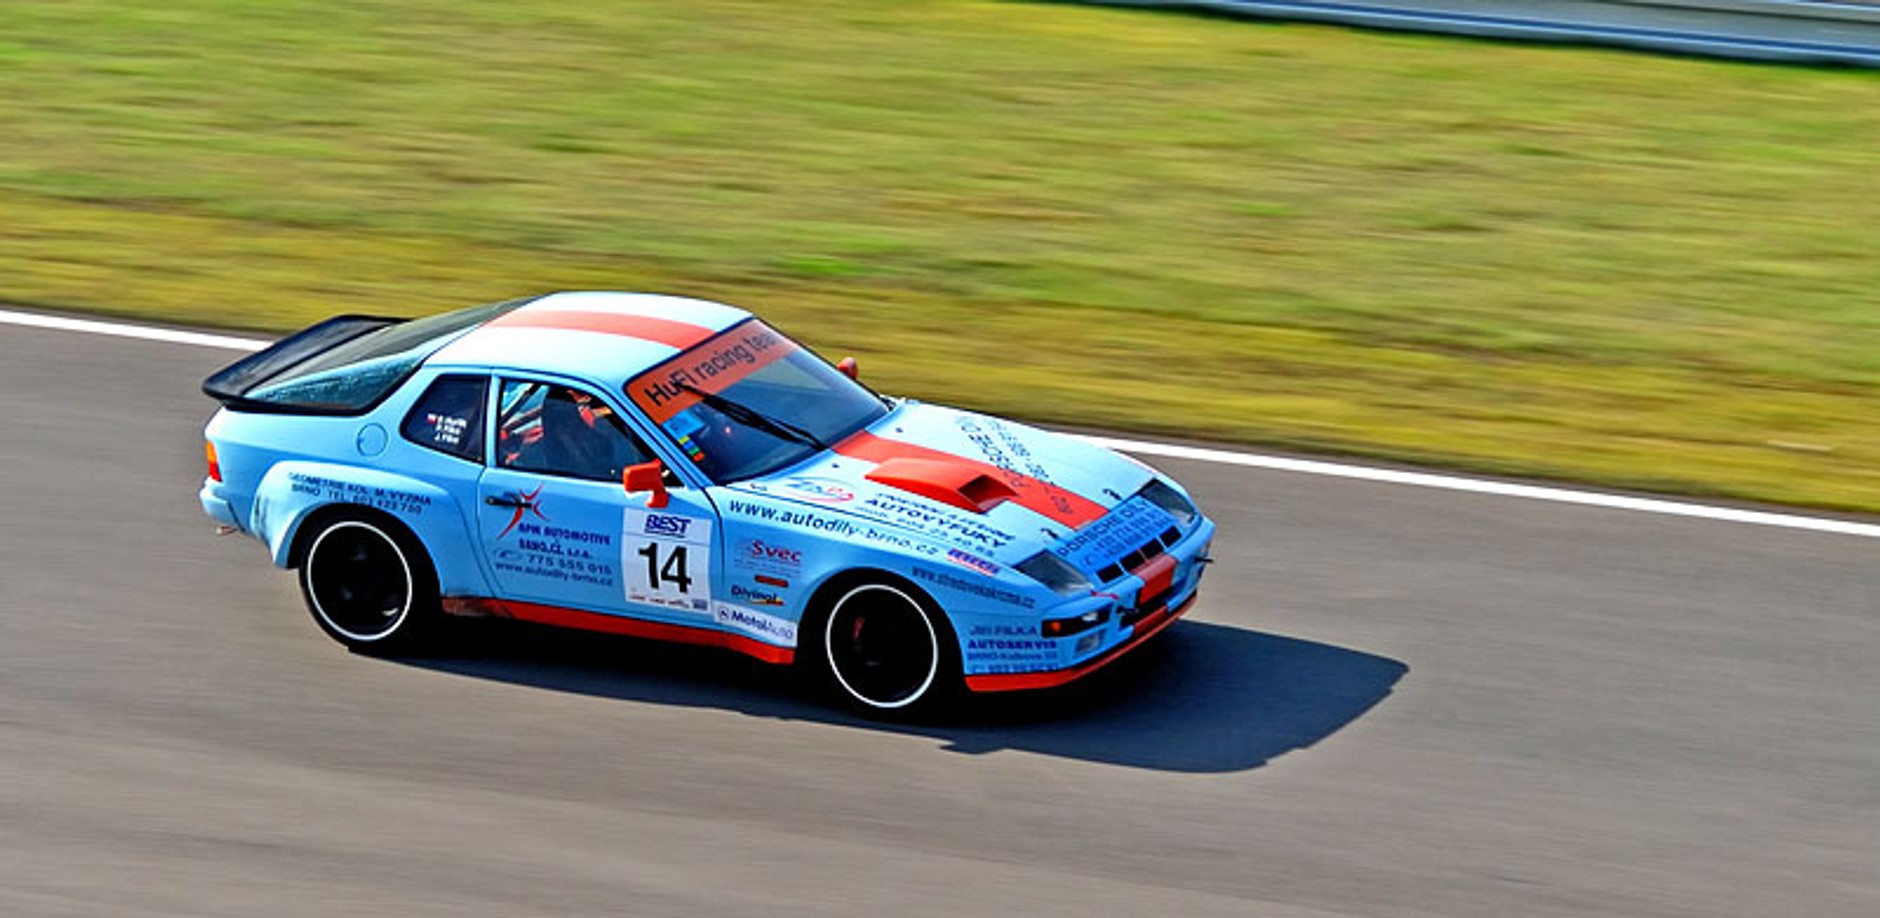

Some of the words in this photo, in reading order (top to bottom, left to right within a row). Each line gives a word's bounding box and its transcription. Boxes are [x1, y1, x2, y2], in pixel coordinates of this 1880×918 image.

[644, 368, 698, 407] HuFi
[695, 344, 755, 380] racing
[743, 331, 782, 352] tea
[645, 513, 693, 535] BEST
[637, 541, 693, 594] 14
[967, 639, 1058, 650] AUTOSERVIS
